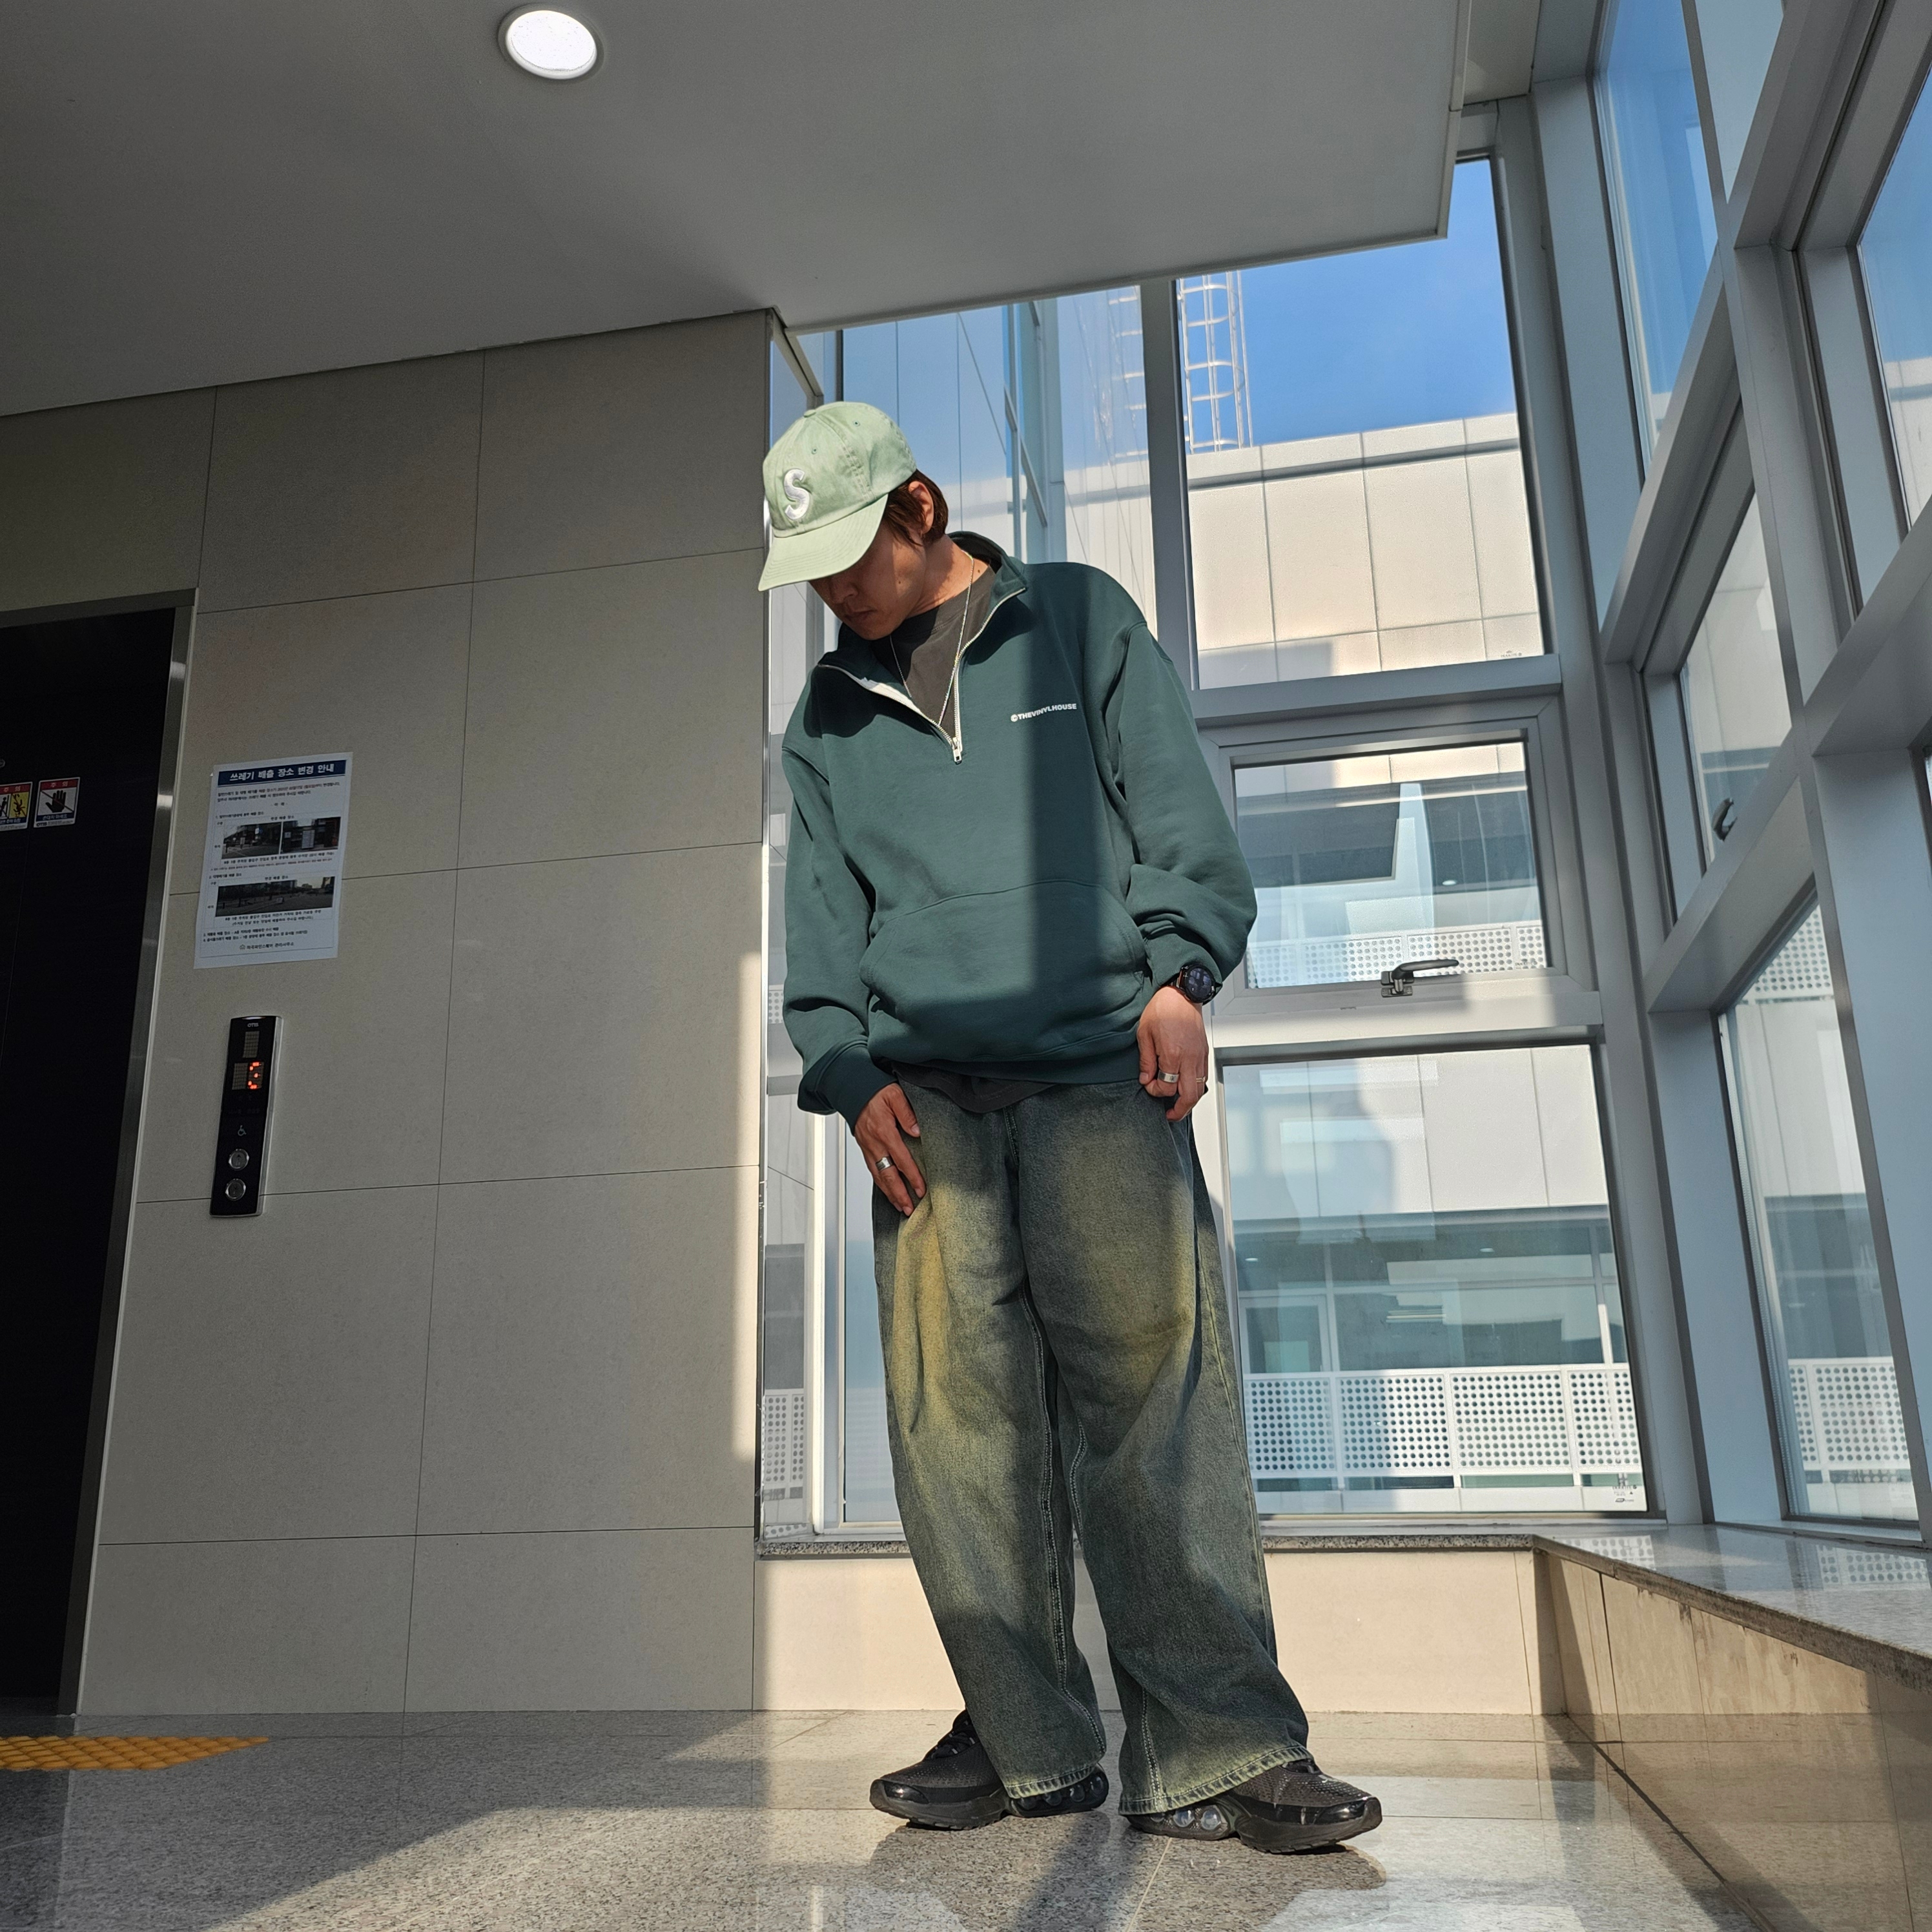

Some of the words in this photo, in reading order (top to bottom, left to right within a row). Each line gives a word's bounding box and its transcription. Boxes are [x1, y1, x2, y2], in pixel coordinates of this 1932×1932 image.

[783, 468, 810, 521] S
[1018, 703, 1077, 720] THEVINYLHOUSE
[229, 771, 254, 781] 쓰레기
[258, 769, 274, 779] 배출
[278, 767, 294, 777] 장소
[298, 765, 314, 775] 변경
[318, 763, 334, 774] 안내
